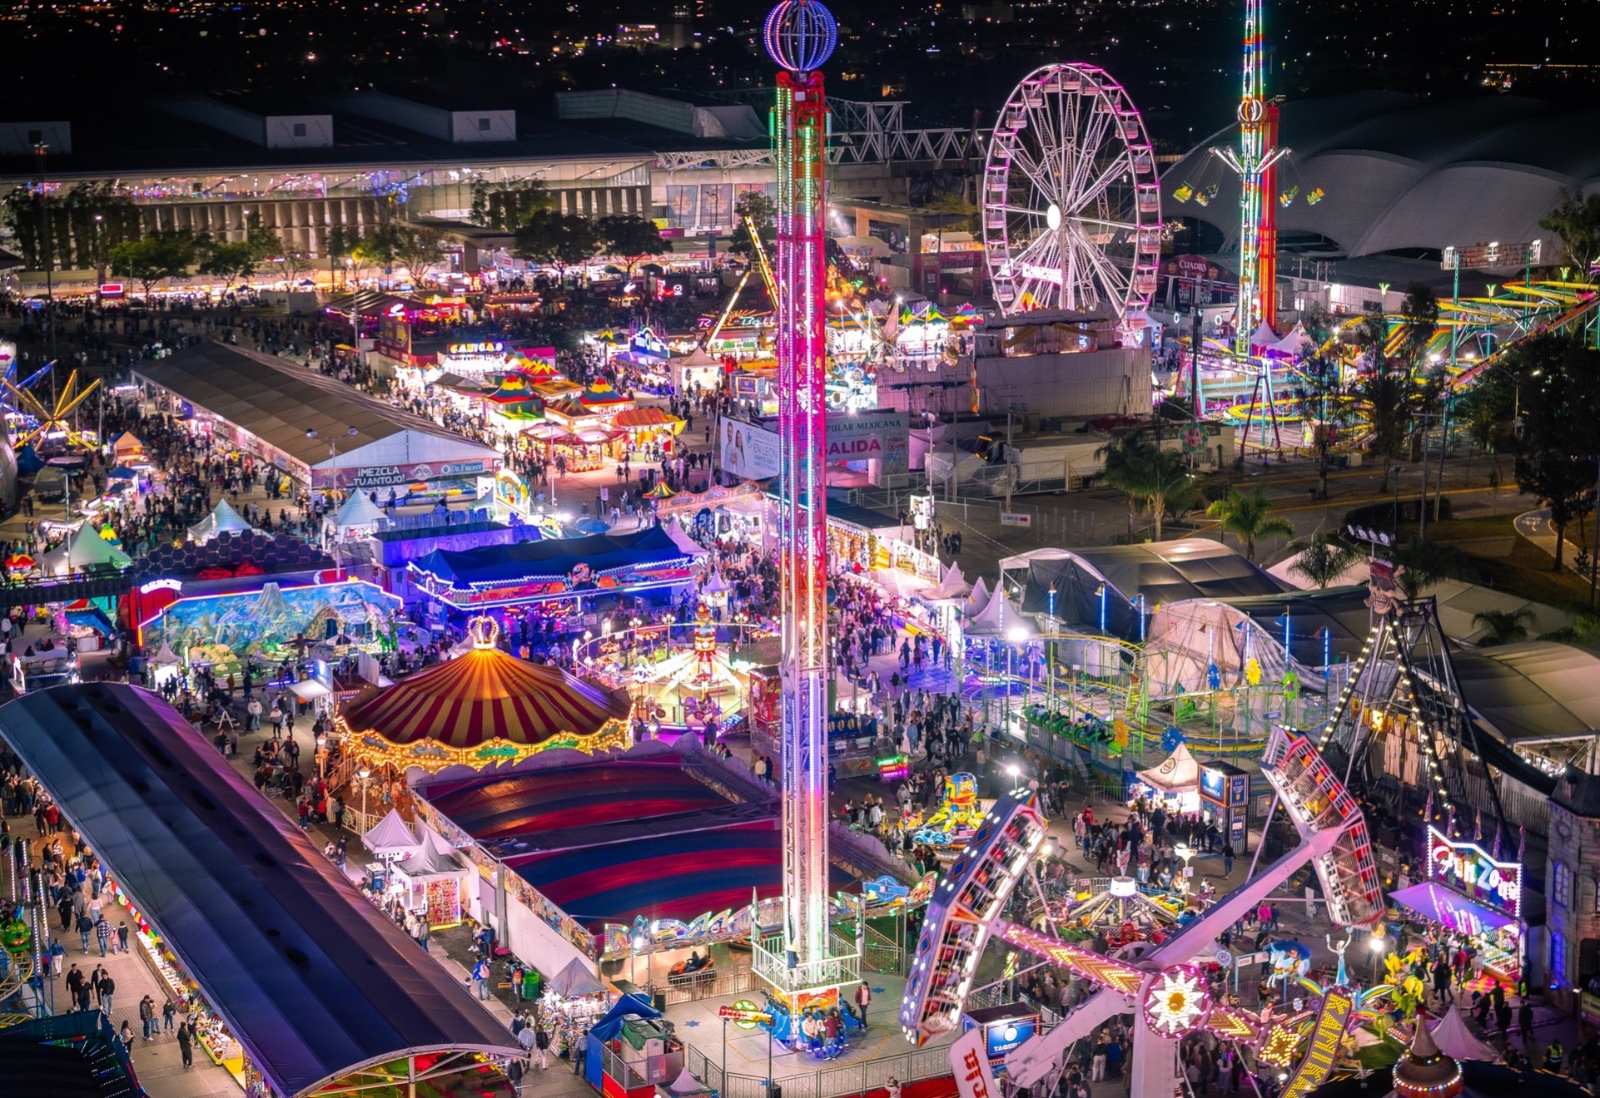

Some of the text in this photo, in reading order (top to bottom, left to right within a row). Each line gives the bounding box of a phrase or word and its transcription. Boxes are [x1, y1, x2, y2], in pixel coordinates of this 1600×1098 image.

[1179, 260, 1207, 273] CUADRA
[826, 420, 901, 433] PULAR MEXICANA
[357, 466, 400, 478] ¡MEZCLA
[353, 474, 405, 486] TU ANTOJO!
[993, 1042, 1018, 1052] TAQUI
